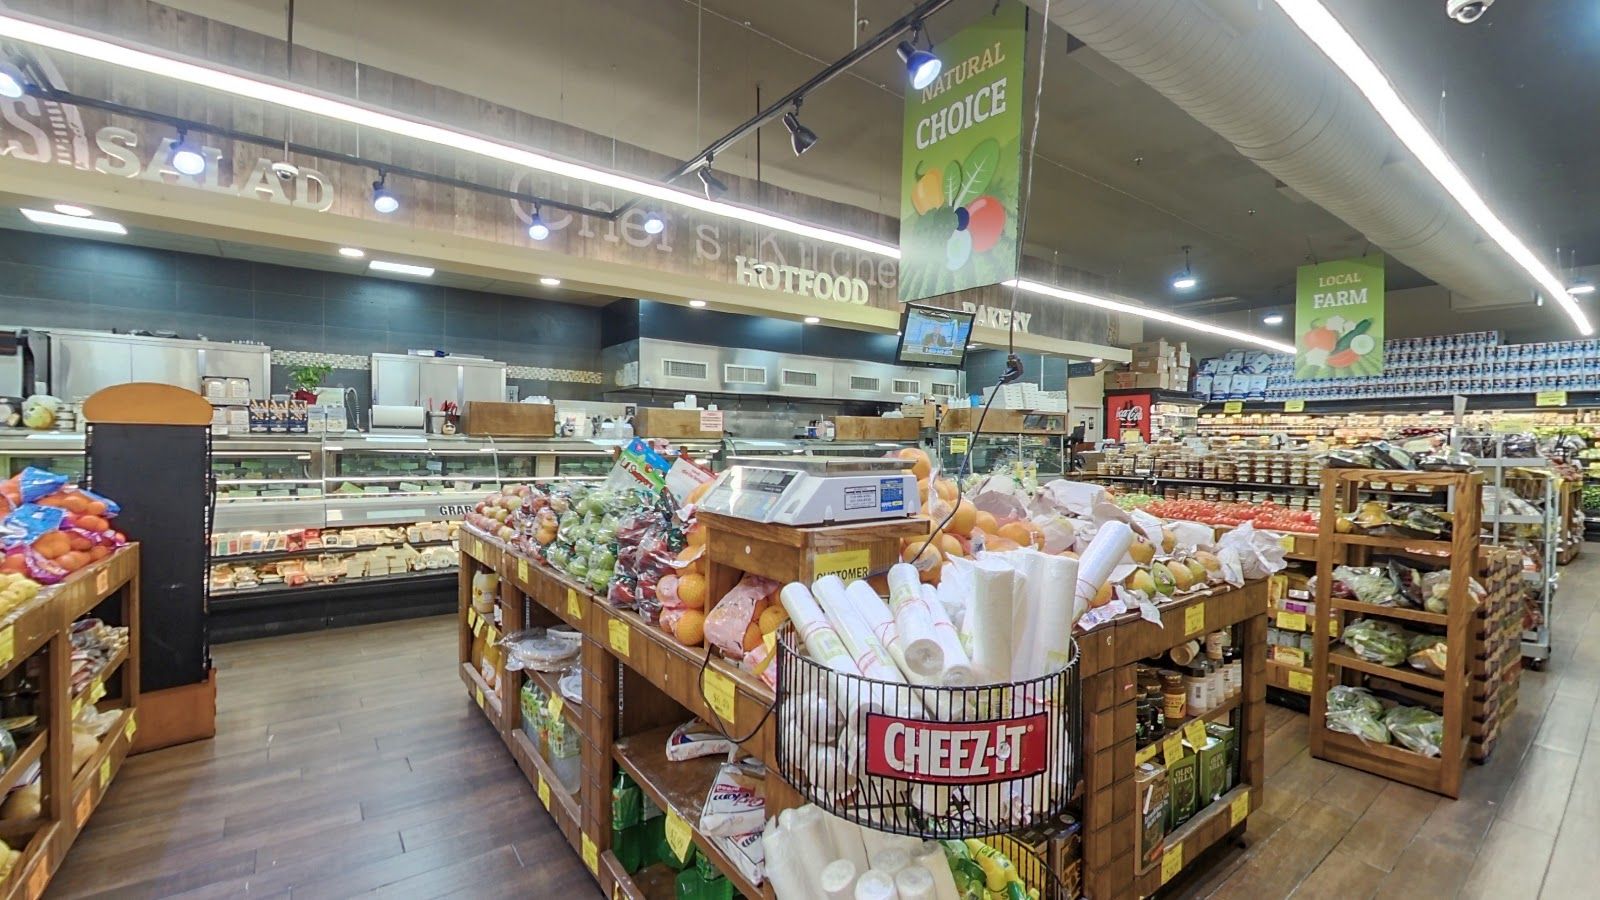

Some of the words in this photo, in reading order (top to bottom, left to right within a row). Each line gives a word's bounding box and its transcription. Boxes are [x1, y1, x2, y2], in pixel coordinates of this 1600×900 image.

[922, 42, 1006, 105] NATURAL
[916, 76, 1008, 150] CHOICE
[95, 126, 335, 213] SALAD
[1313, 287, 1368, 309] FARM
[1319, 272, 1362, 288] LOCAL
[816, 566, 868, 580] TOMER
[884, 722, 1027, 777] CHEEZ-IT
